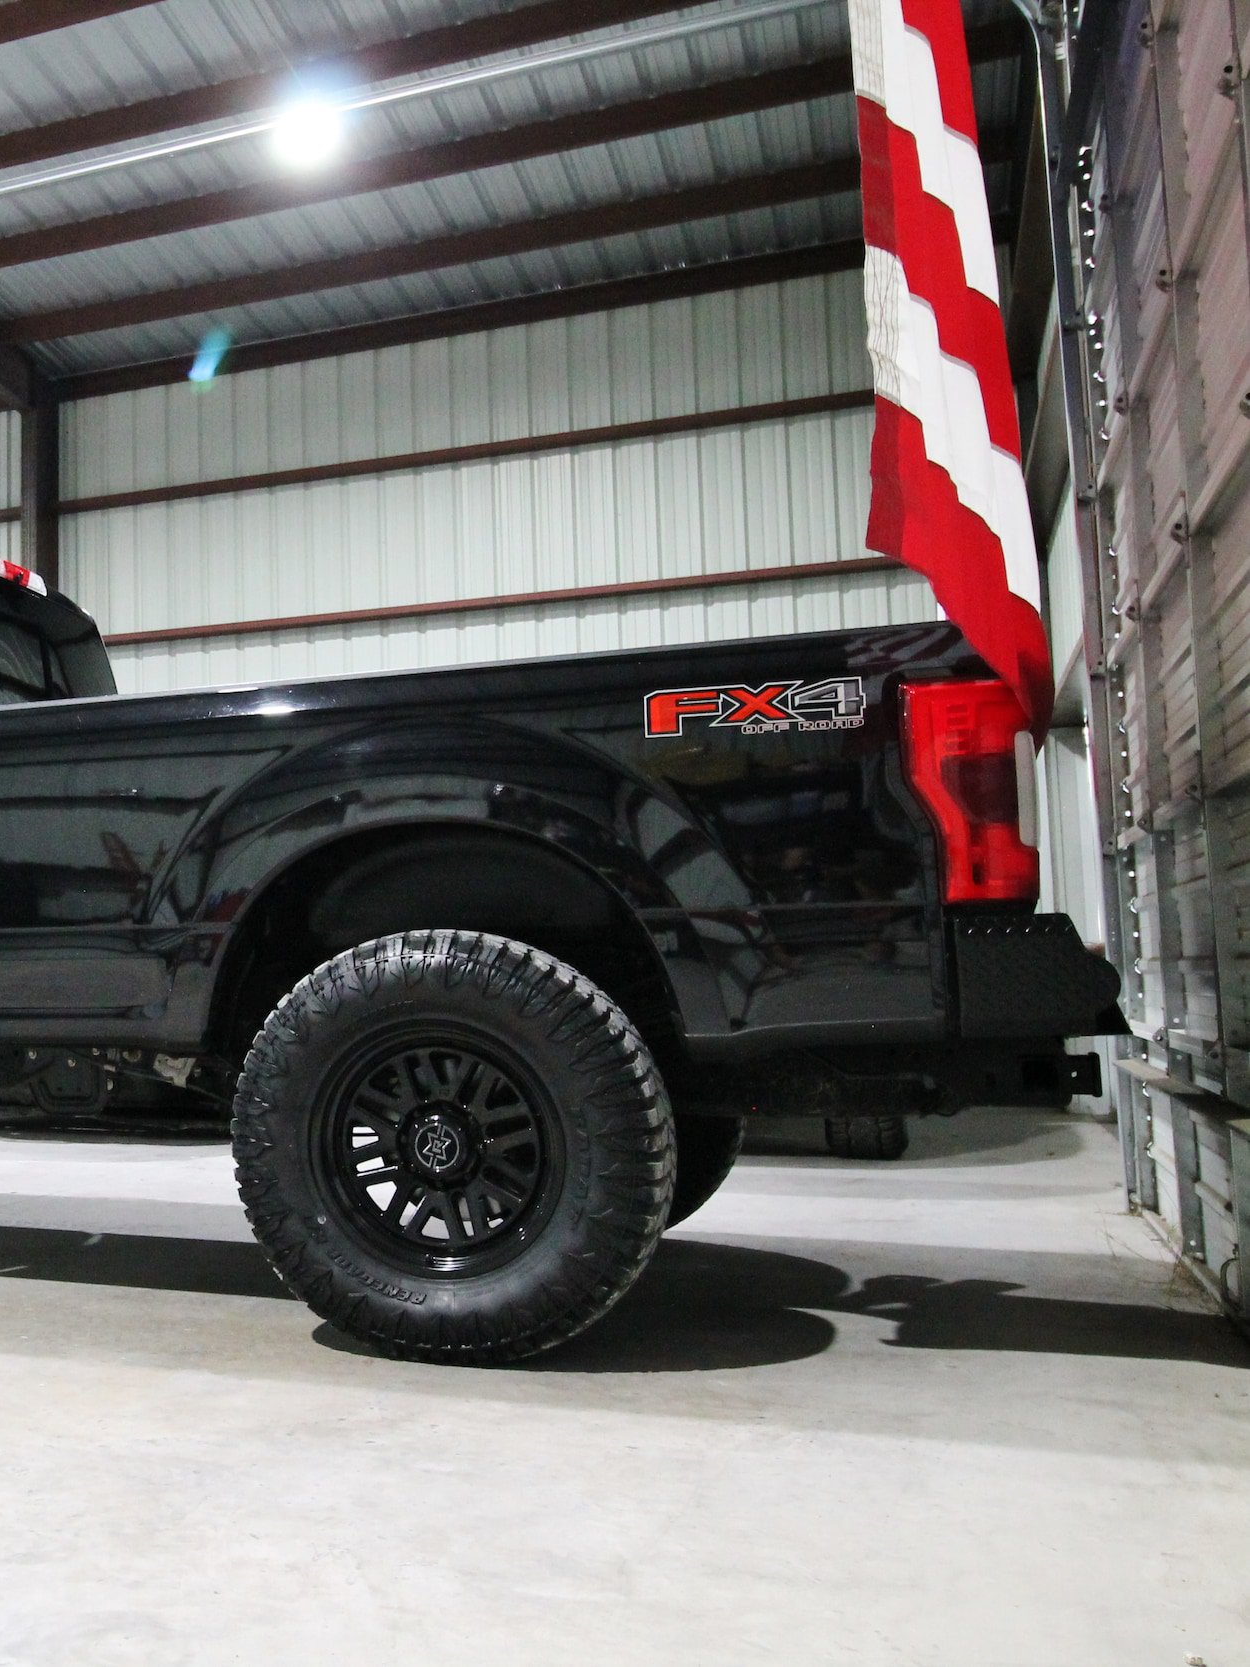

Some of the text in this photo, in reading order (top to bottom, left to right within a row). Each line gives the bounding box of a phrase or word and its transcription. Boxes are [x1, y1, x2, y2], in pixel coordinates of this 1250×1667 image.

[644, 676, 867, 738] FX4
[741, 718, 865, 735] OFF ROAD
